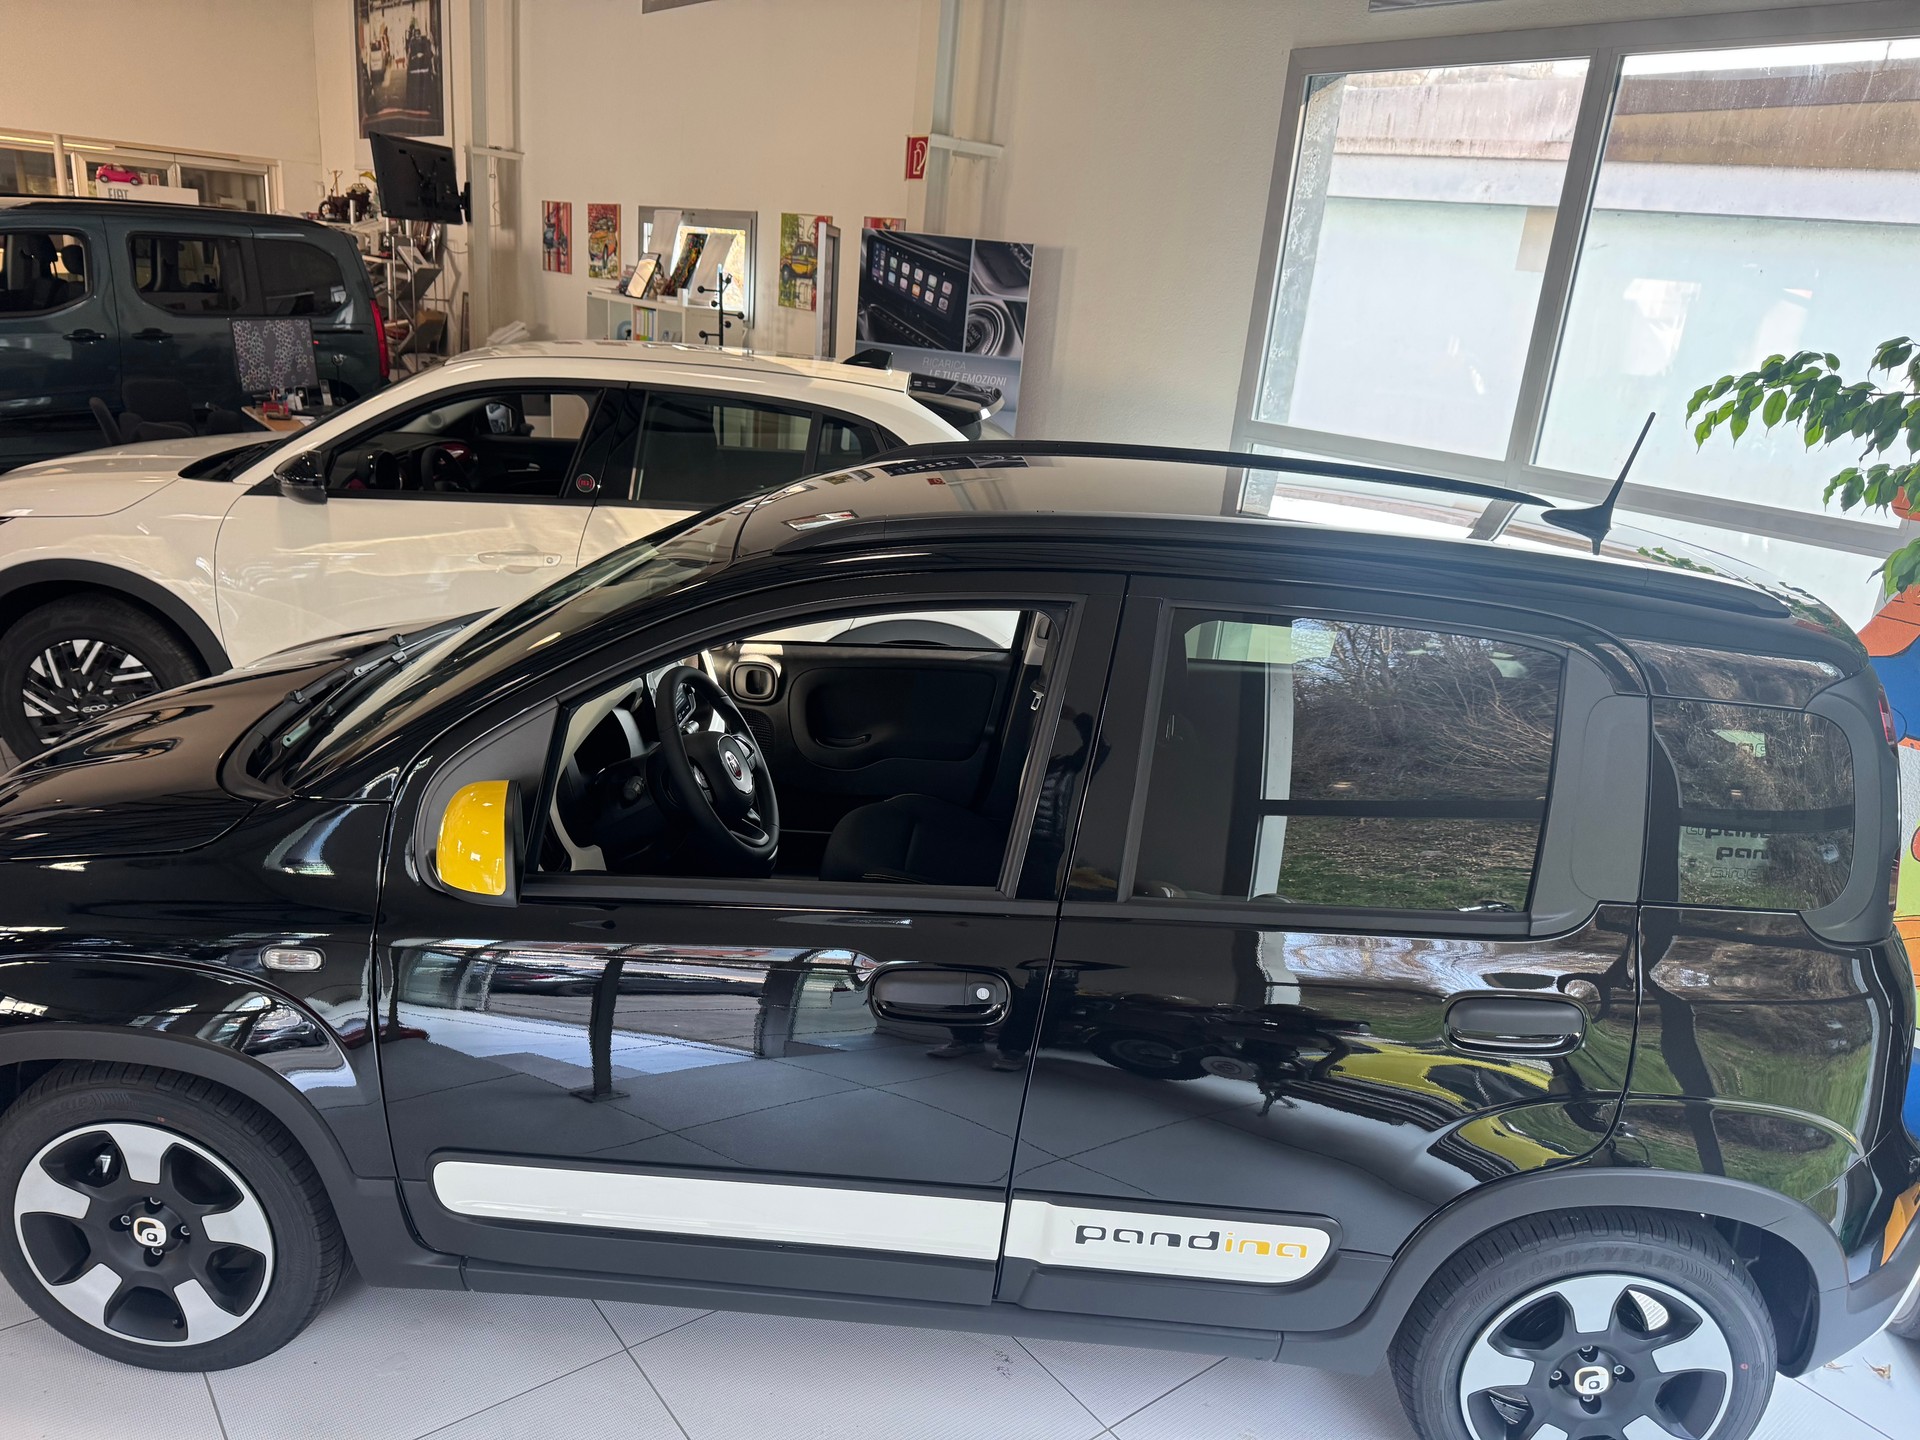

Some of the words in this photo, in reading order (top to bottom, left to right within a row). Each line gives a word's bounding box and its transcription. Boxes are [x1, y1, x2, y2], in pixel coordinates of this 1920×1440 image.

[107, 187, 129, 200] FIAT
[922, 356, 967, 370] RICARICA
[942, 371, 961, 381] TUE
[961, 373, 1008, 387] EMOZIONI
[1074, 1224, 1309, 1260] pandina
